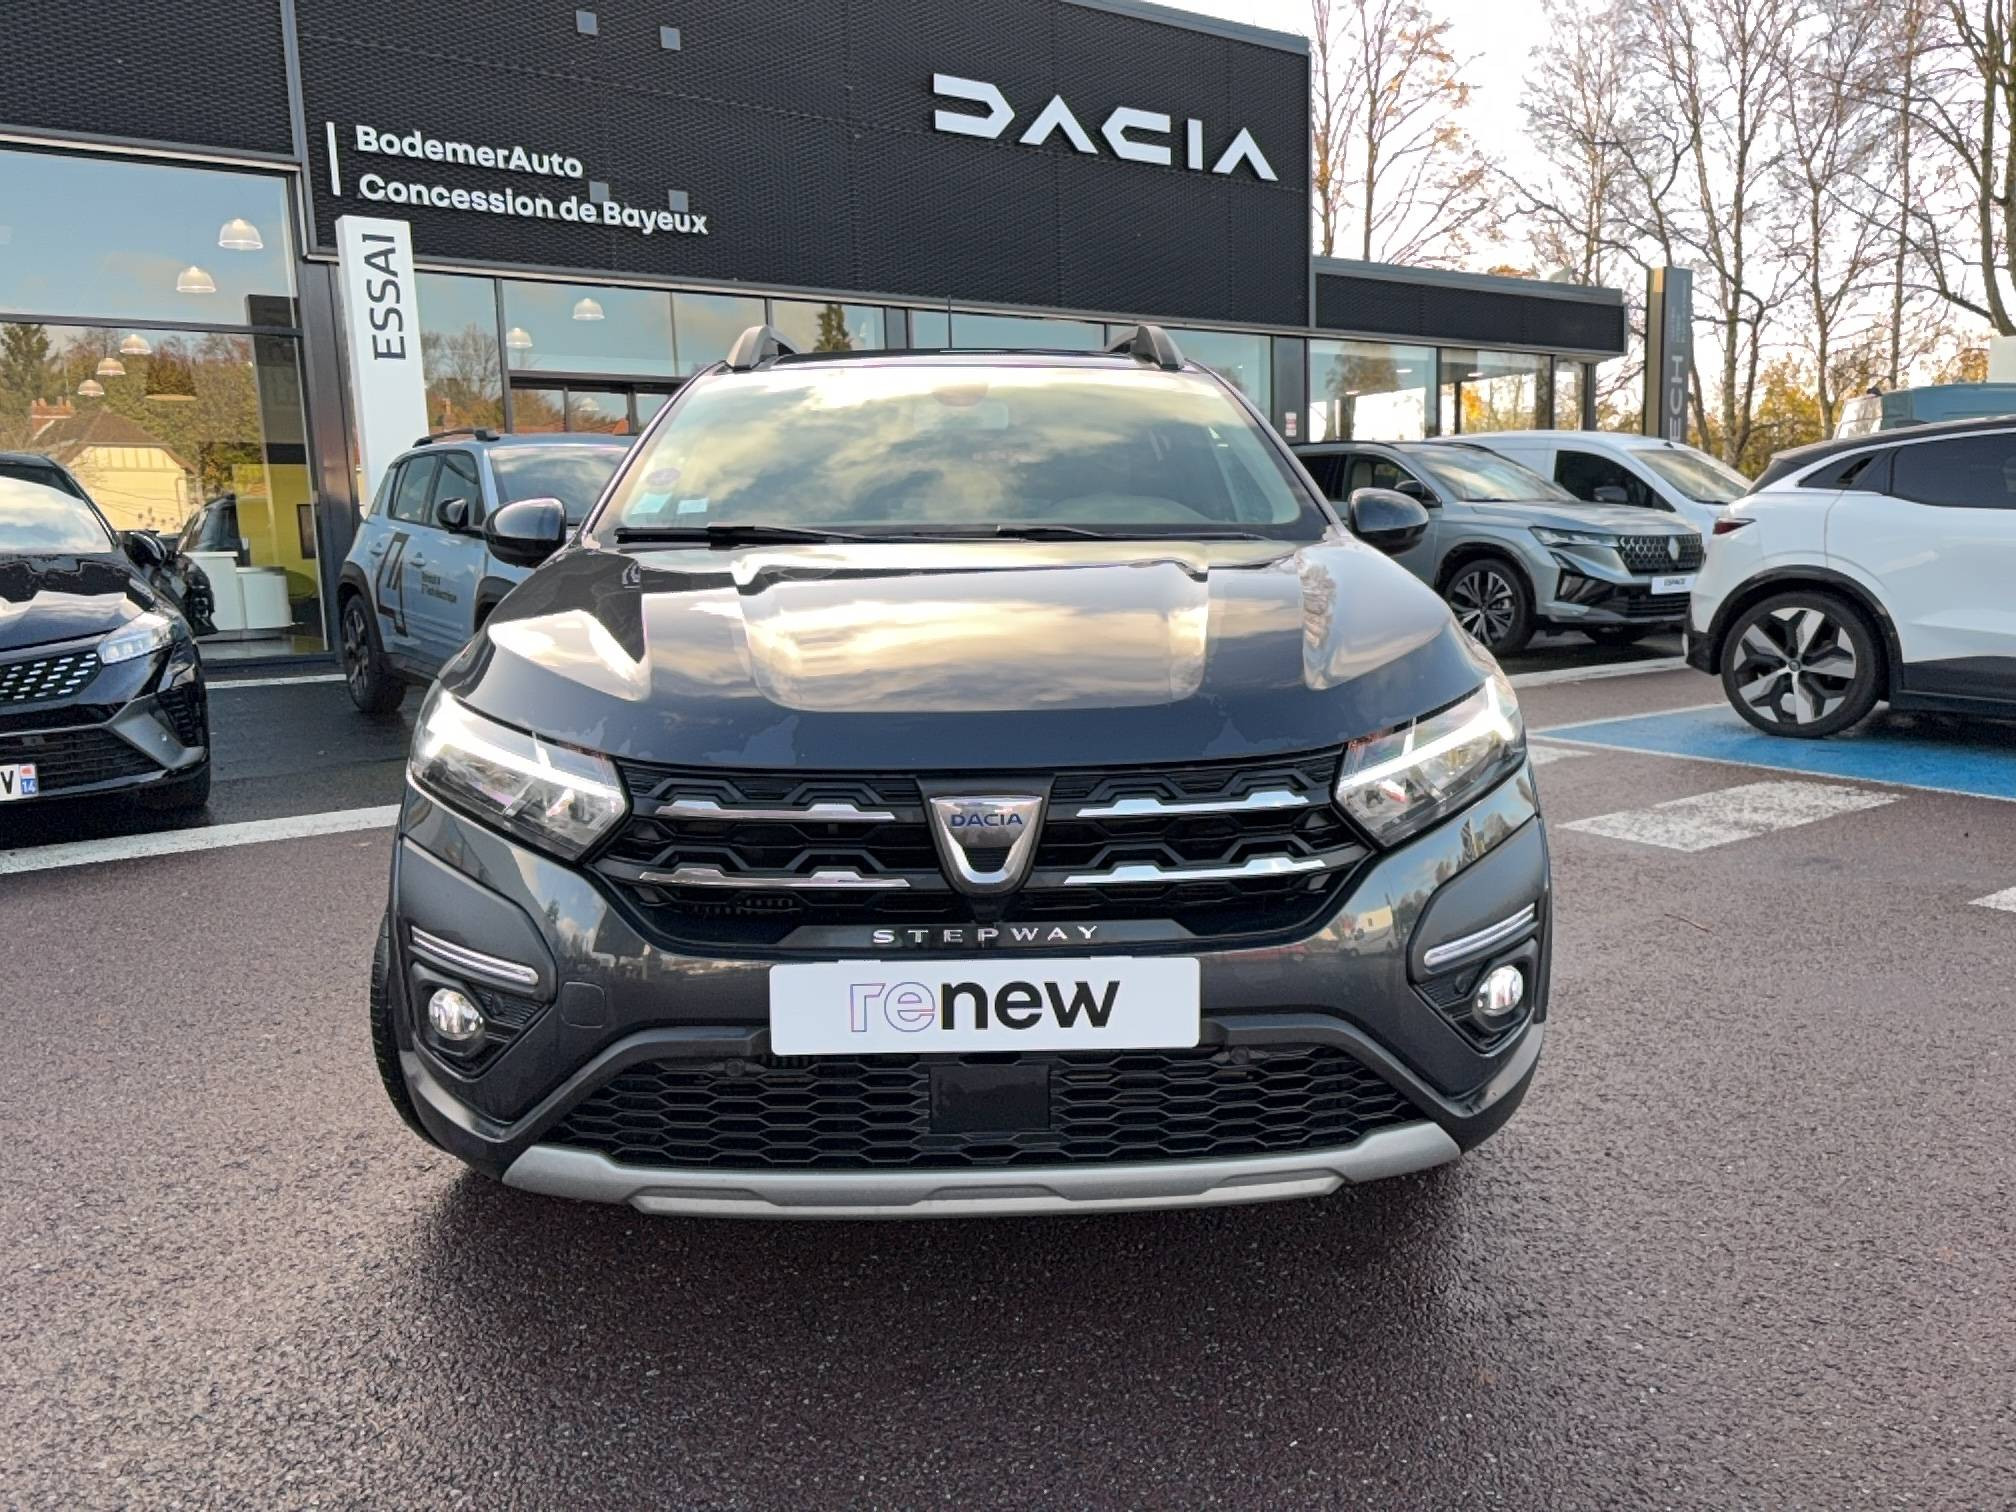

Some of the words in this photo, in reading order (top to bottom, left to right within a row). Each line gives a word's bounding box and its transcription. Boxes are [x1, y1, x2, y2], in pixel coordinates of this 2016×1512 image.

[355, 125, 583, 178] BodemerAuto
[933, 73, 1278, 181] DACIA
[358, 173, 553, 217] Concession
[559, 196, 597, 223] de
[603, 201, 709, 235] Bayeux
[361, 233, 406, 360] ESSAI
[22, 779, 36, 792] 14
[951, 813, 1023, 827] DACIA
[872, 925, 1098, 944] STEPWAY
[849, 980, 1120, 1033] renew
